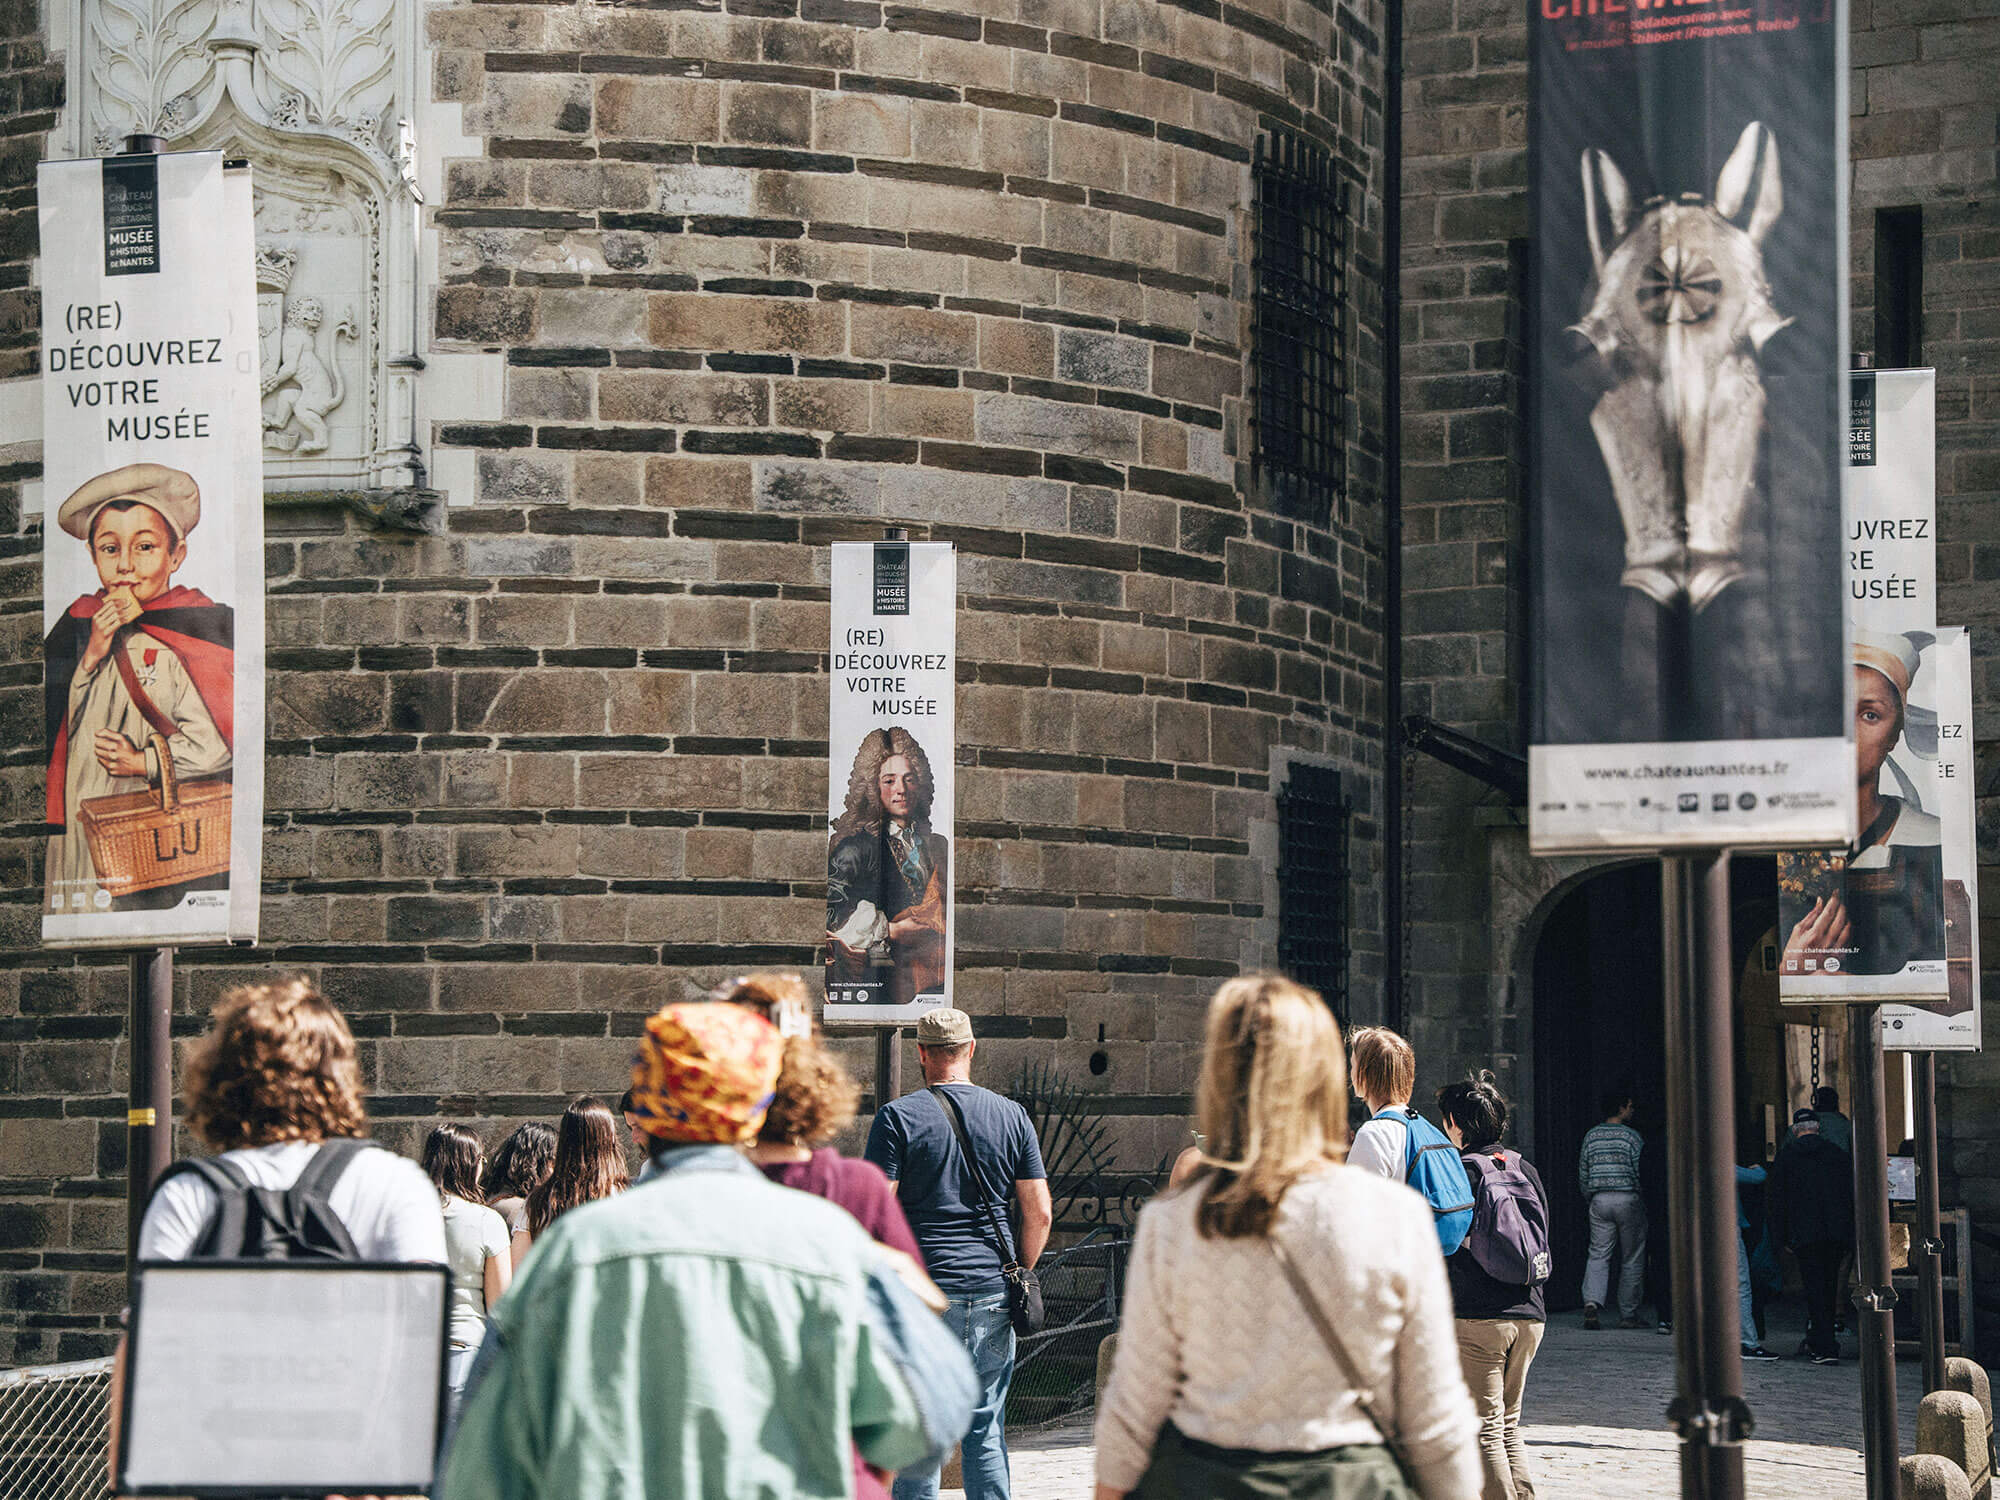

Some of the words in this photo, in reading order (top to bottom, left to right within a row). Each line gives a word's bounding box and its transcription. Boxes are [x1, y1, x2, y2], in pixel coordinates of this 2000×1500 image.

[109, 228, 154, 245] MUSÉE
[120, 256, 154, 267] NANTES
[66, 300, 122, 334] (RE)
[50, 338, 222, 372] DÉCOUVREZ
[67, 379, 160, 408] VOTRE
[107, 408, 211, 442] MUSÉE
[1848, 430, 1871, 442] SÉE
[1849, 452, 1871, 460] NTES
[1848, 519, 1929, 540] UVREZ
[877, 587, 906, 597] MUSÉE
[1851, 573, 1917, 599] USÉE
[846, 628, 885, 647] (RE)
[835, 650, 946, 670] DÉCOUVREZ
[846, 677, 906, 693] VOTRE
[872, 695, 937, 715] MUSÉE
[1583, 761, 1789, 780] www.chateaunantes.fr
[153, 818, 200, 862] LU
